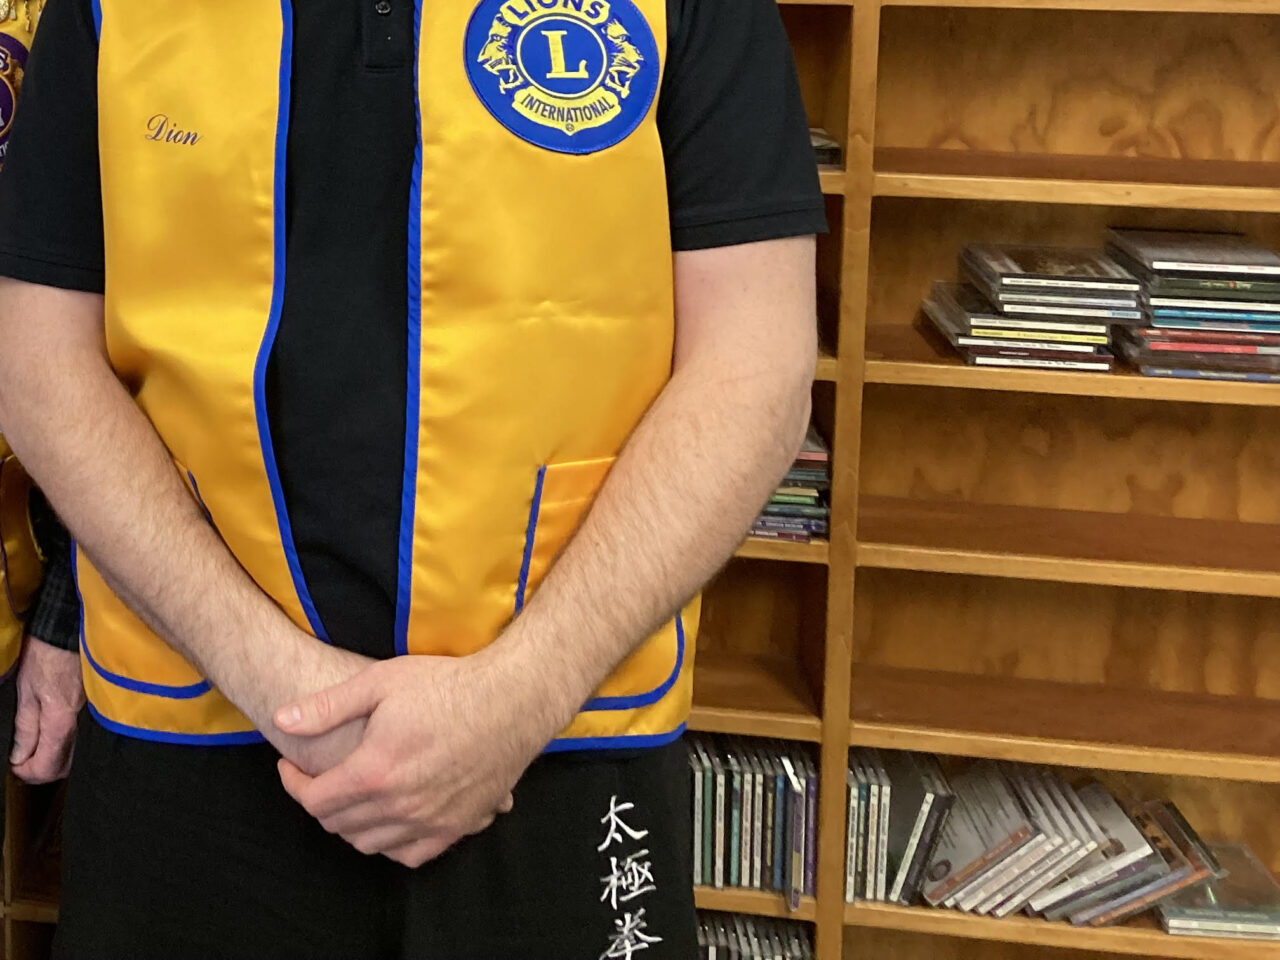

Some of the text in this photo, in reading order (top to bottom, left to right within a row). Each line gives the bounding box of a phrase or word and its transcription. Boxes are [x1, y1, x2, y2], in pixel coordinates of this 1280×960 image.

[540, 30, 589, 79] L
[520, 93, 615, 123] INTERNATIONAL
[145, 113, 203, 146] Dion
